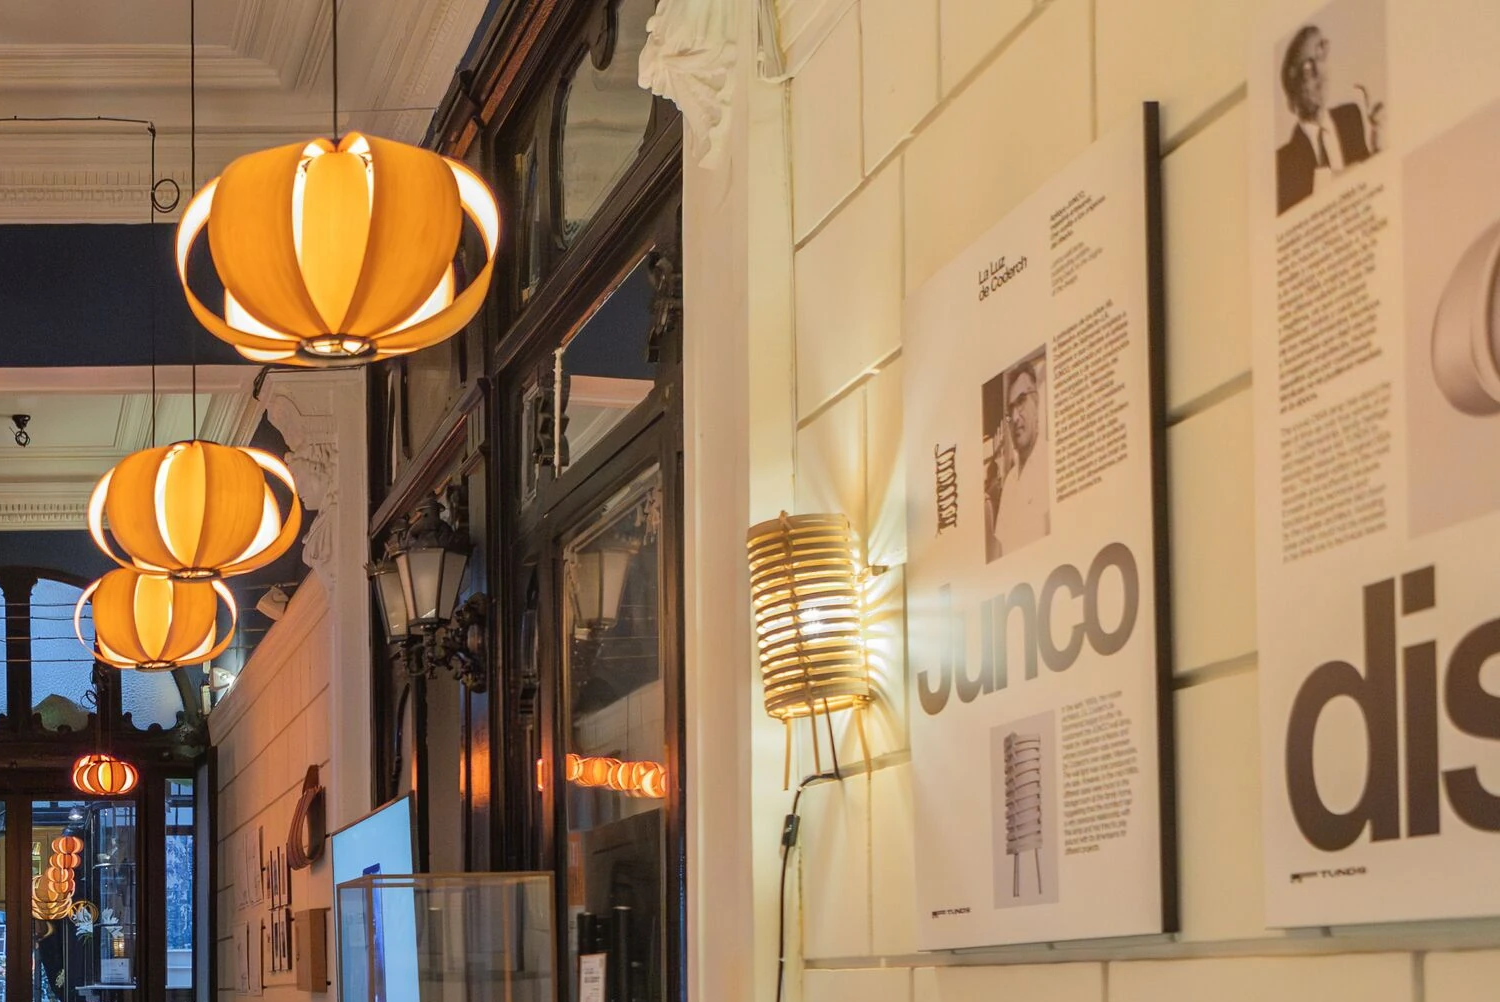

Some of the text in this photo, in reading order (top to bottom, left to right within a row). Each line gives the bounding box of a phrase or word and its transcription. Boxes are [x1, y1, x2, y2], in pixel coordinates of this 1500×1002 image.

[979, 256, 1006, 285] La Luz
[979, 285, 989, 301] de
[991, 256, 1028, 292] Coderch
[918, 542, 1140, 716] Junco
